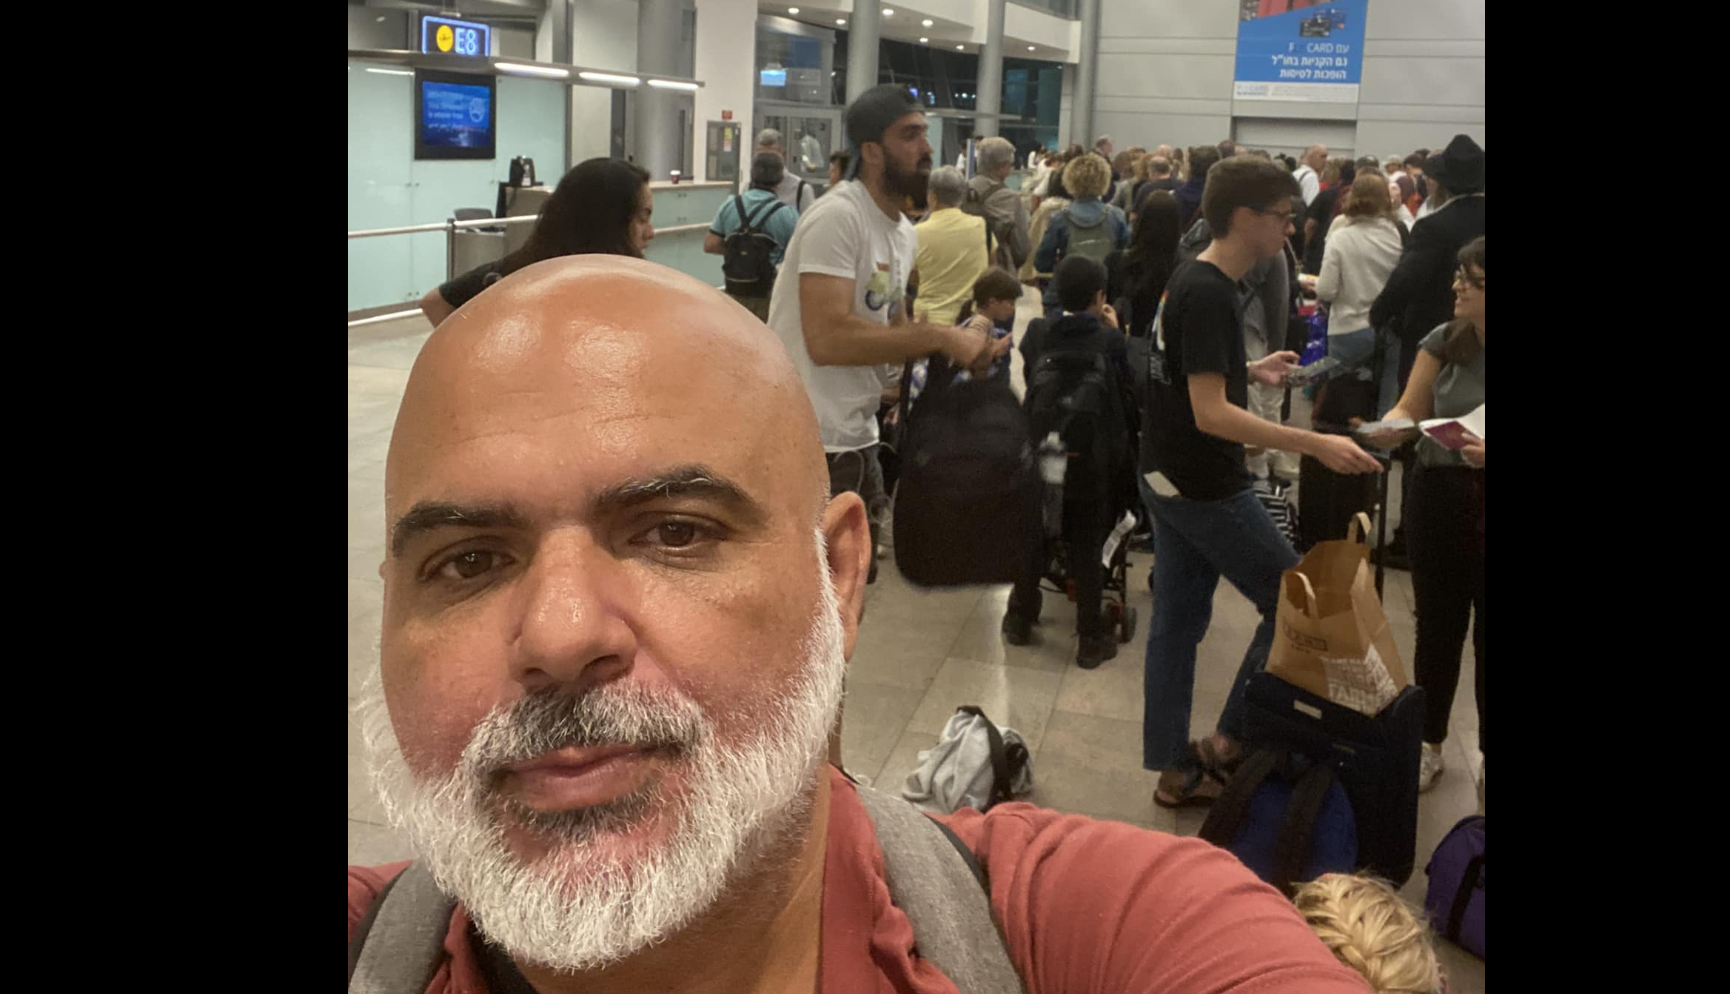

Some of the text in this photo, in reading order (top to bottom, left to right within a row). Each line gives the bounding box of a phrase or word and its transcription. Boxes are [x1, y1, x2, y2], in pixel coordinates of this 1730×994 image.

[455, 27, 476, 55] E8
[1335, 43, 1350, 53] עם
[1300, 56, 1333, 69] הקניות
[1335, 57, 1348, 67] גם
[1279, 68, 1347, 79] הופכות לטיסות
